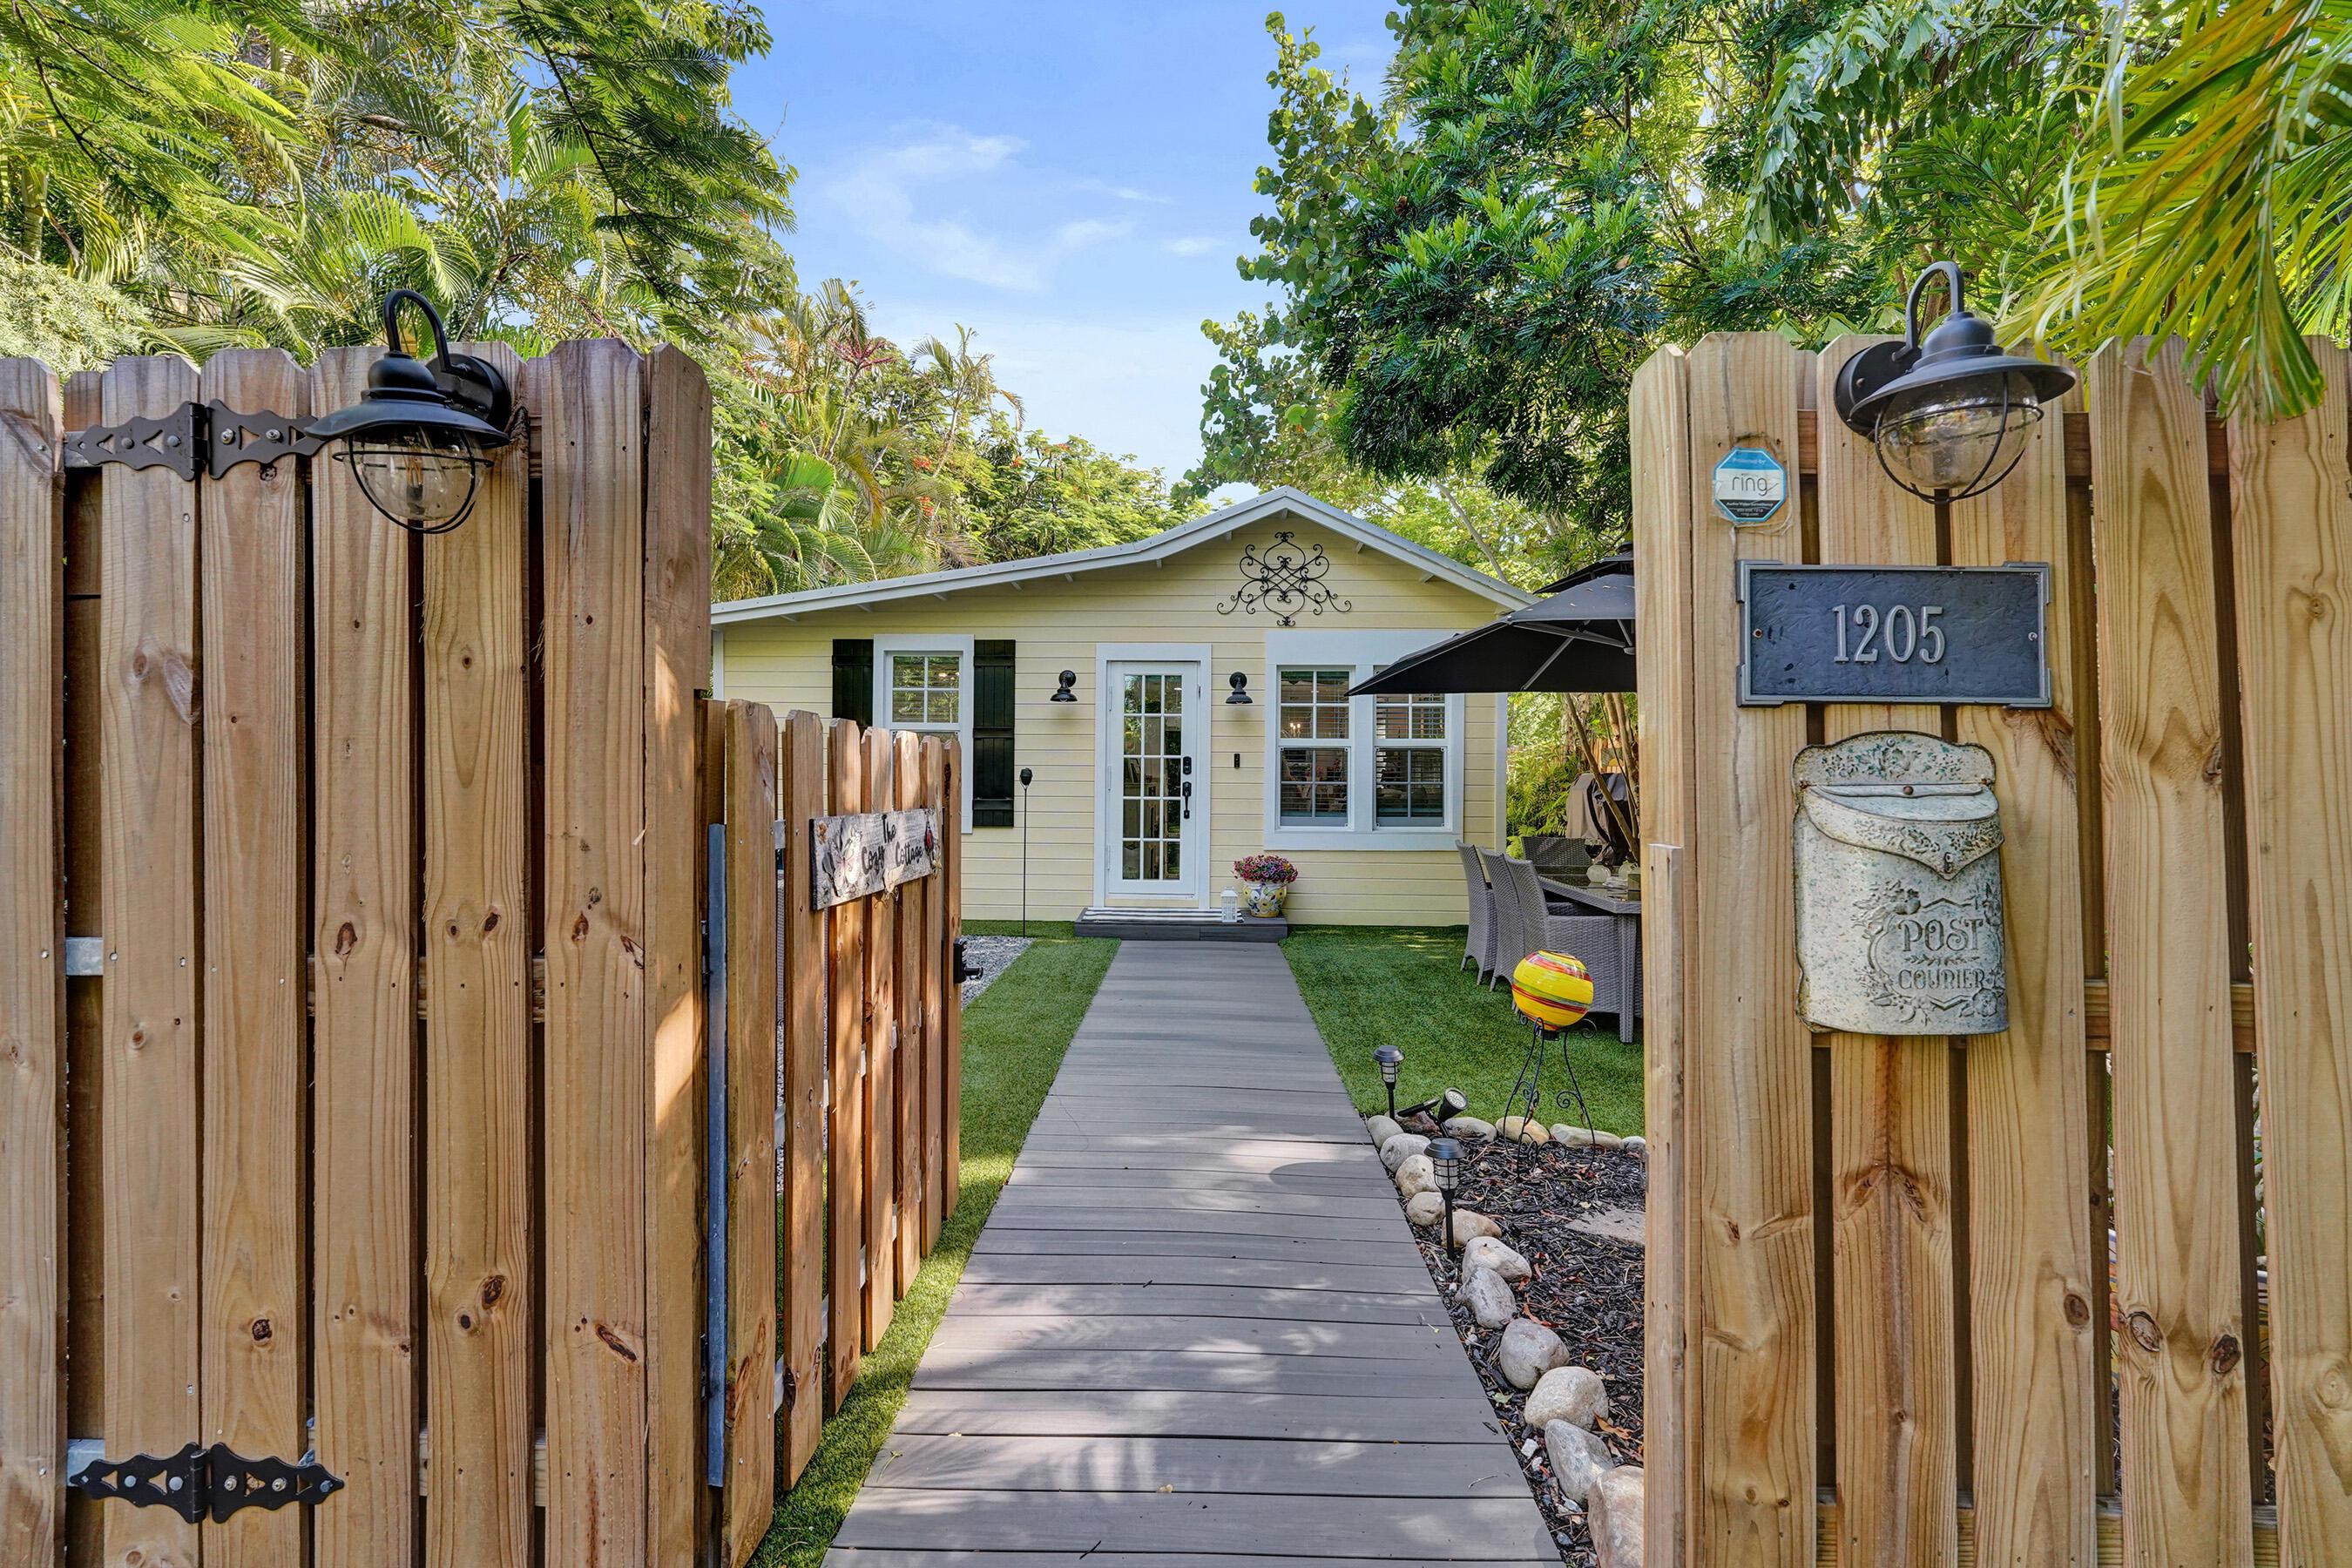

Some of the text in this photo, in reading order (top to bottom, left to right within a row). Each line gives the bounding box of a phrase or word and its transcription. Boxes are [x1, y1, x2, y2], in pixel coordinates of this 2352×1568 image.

[1732, 475, 1771, 497] ring
[1832, 605, 1945, 663] 1205
[882, 814, 896, 844] The
[896, 841, 923, 866] Cottage
[1898, 918, 1984, 952] POST
[1898, 968, 1985, 990] COURIER
